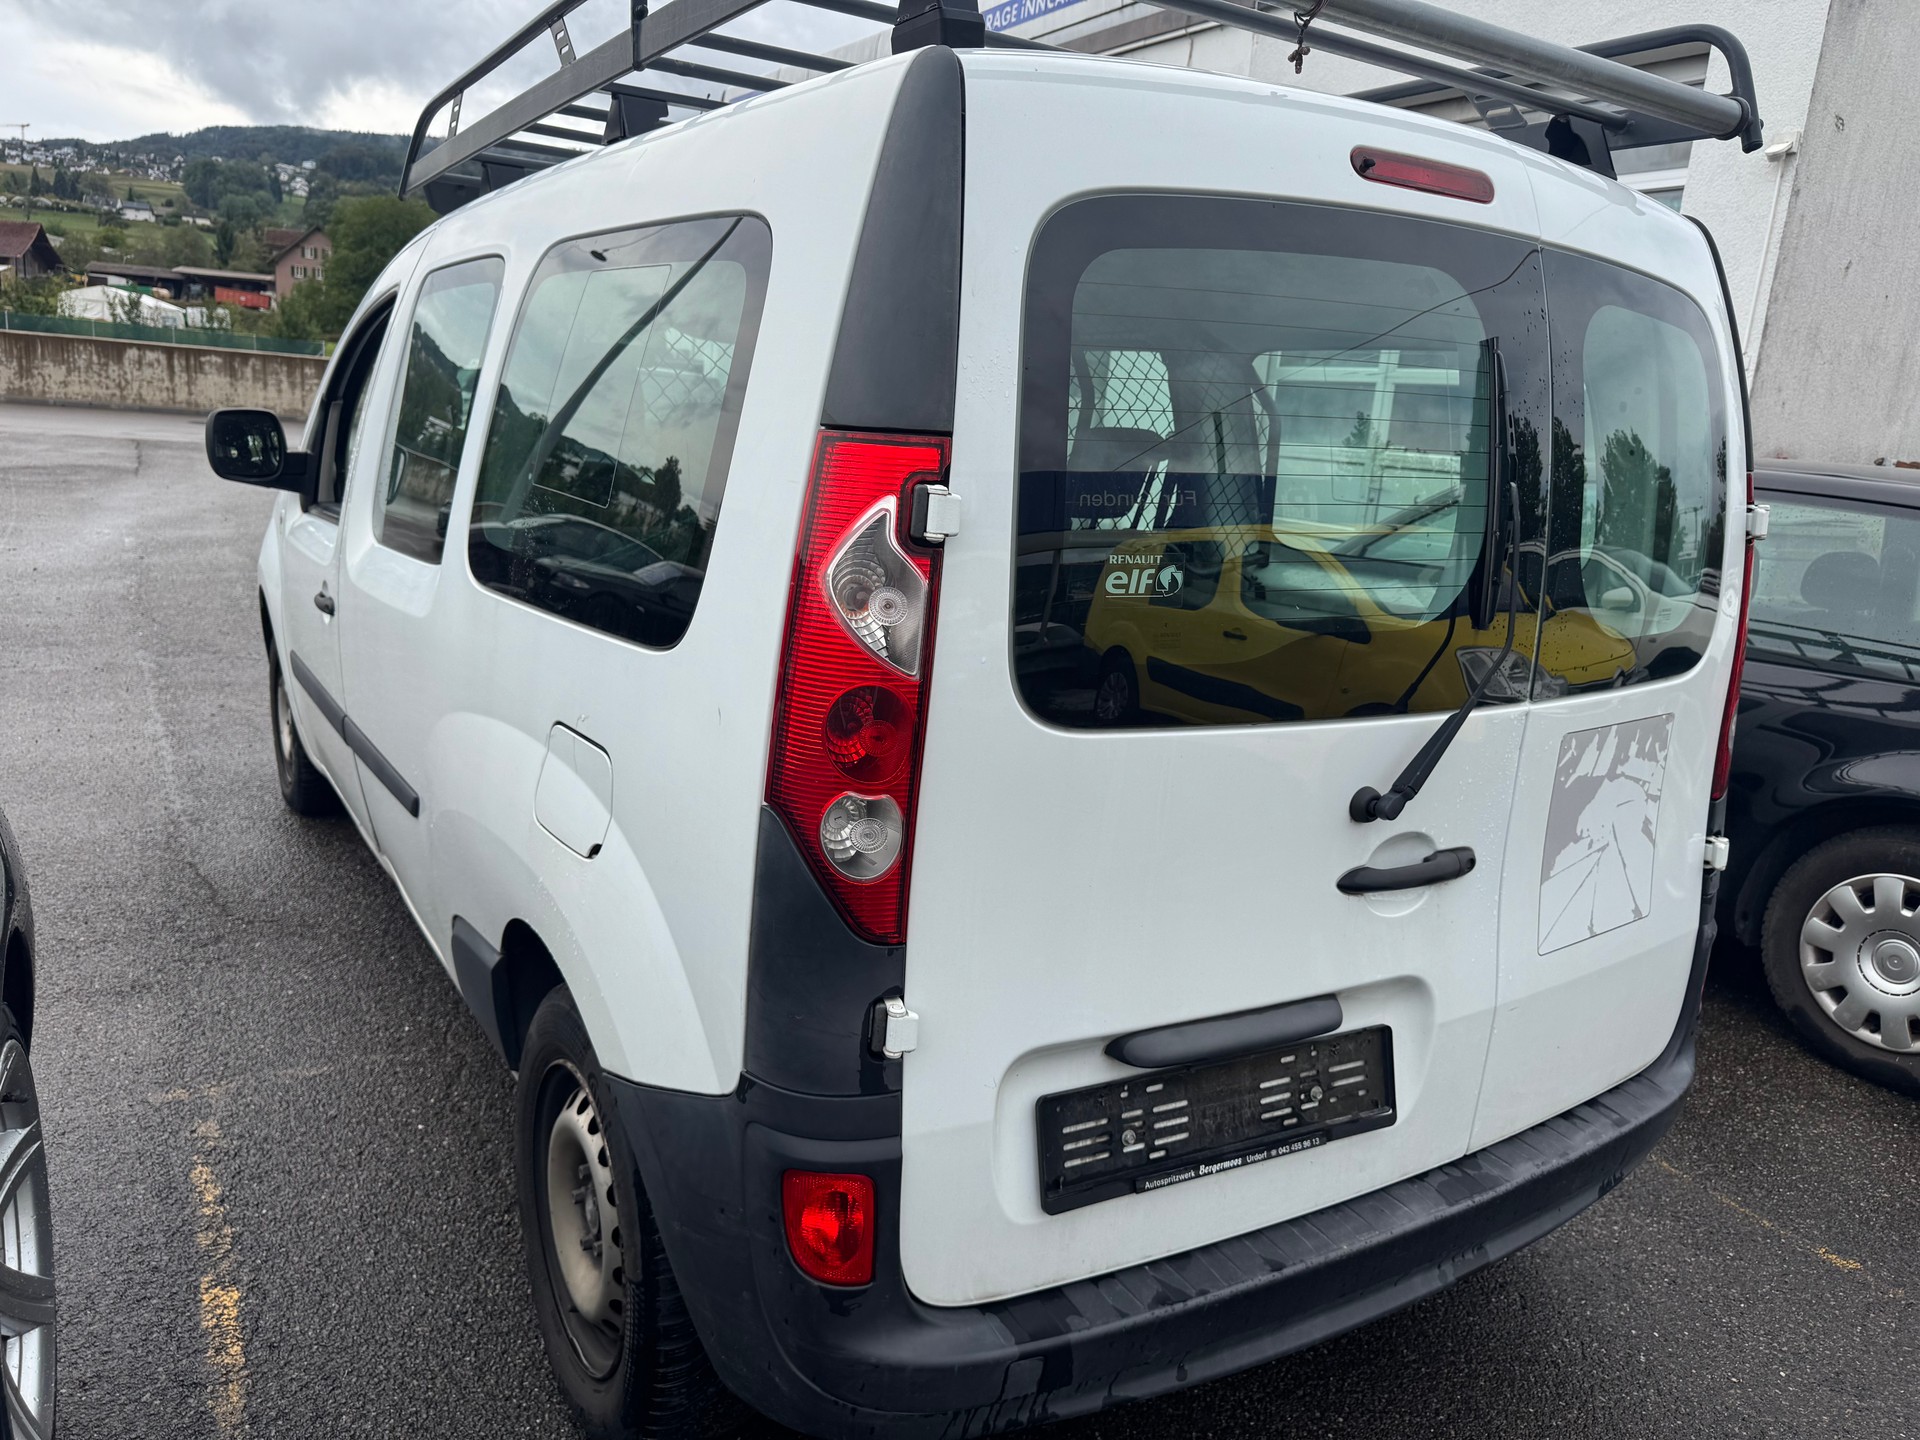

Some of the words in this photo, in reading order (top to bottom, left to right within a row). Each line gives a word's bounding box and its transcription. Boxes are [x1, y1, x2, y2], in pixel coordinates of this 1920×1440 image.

[985, 3, 1019, 30] RAGE
[1109, 554, 1163, 565] RENAULT
[1105, 568, 1156, 594] elf
[1144, 1169, 1196, 1189] Autospritzwerk
[1199, 1157, 1242, 1175] Bergermoos
[1246, 1150, 1267, 1163] Urdorf
[1278, 1145, 1290, 1155] 043
[1290, 1141, 1302, 1151] 455
[1312, 1137, 1320, 1145] 13
